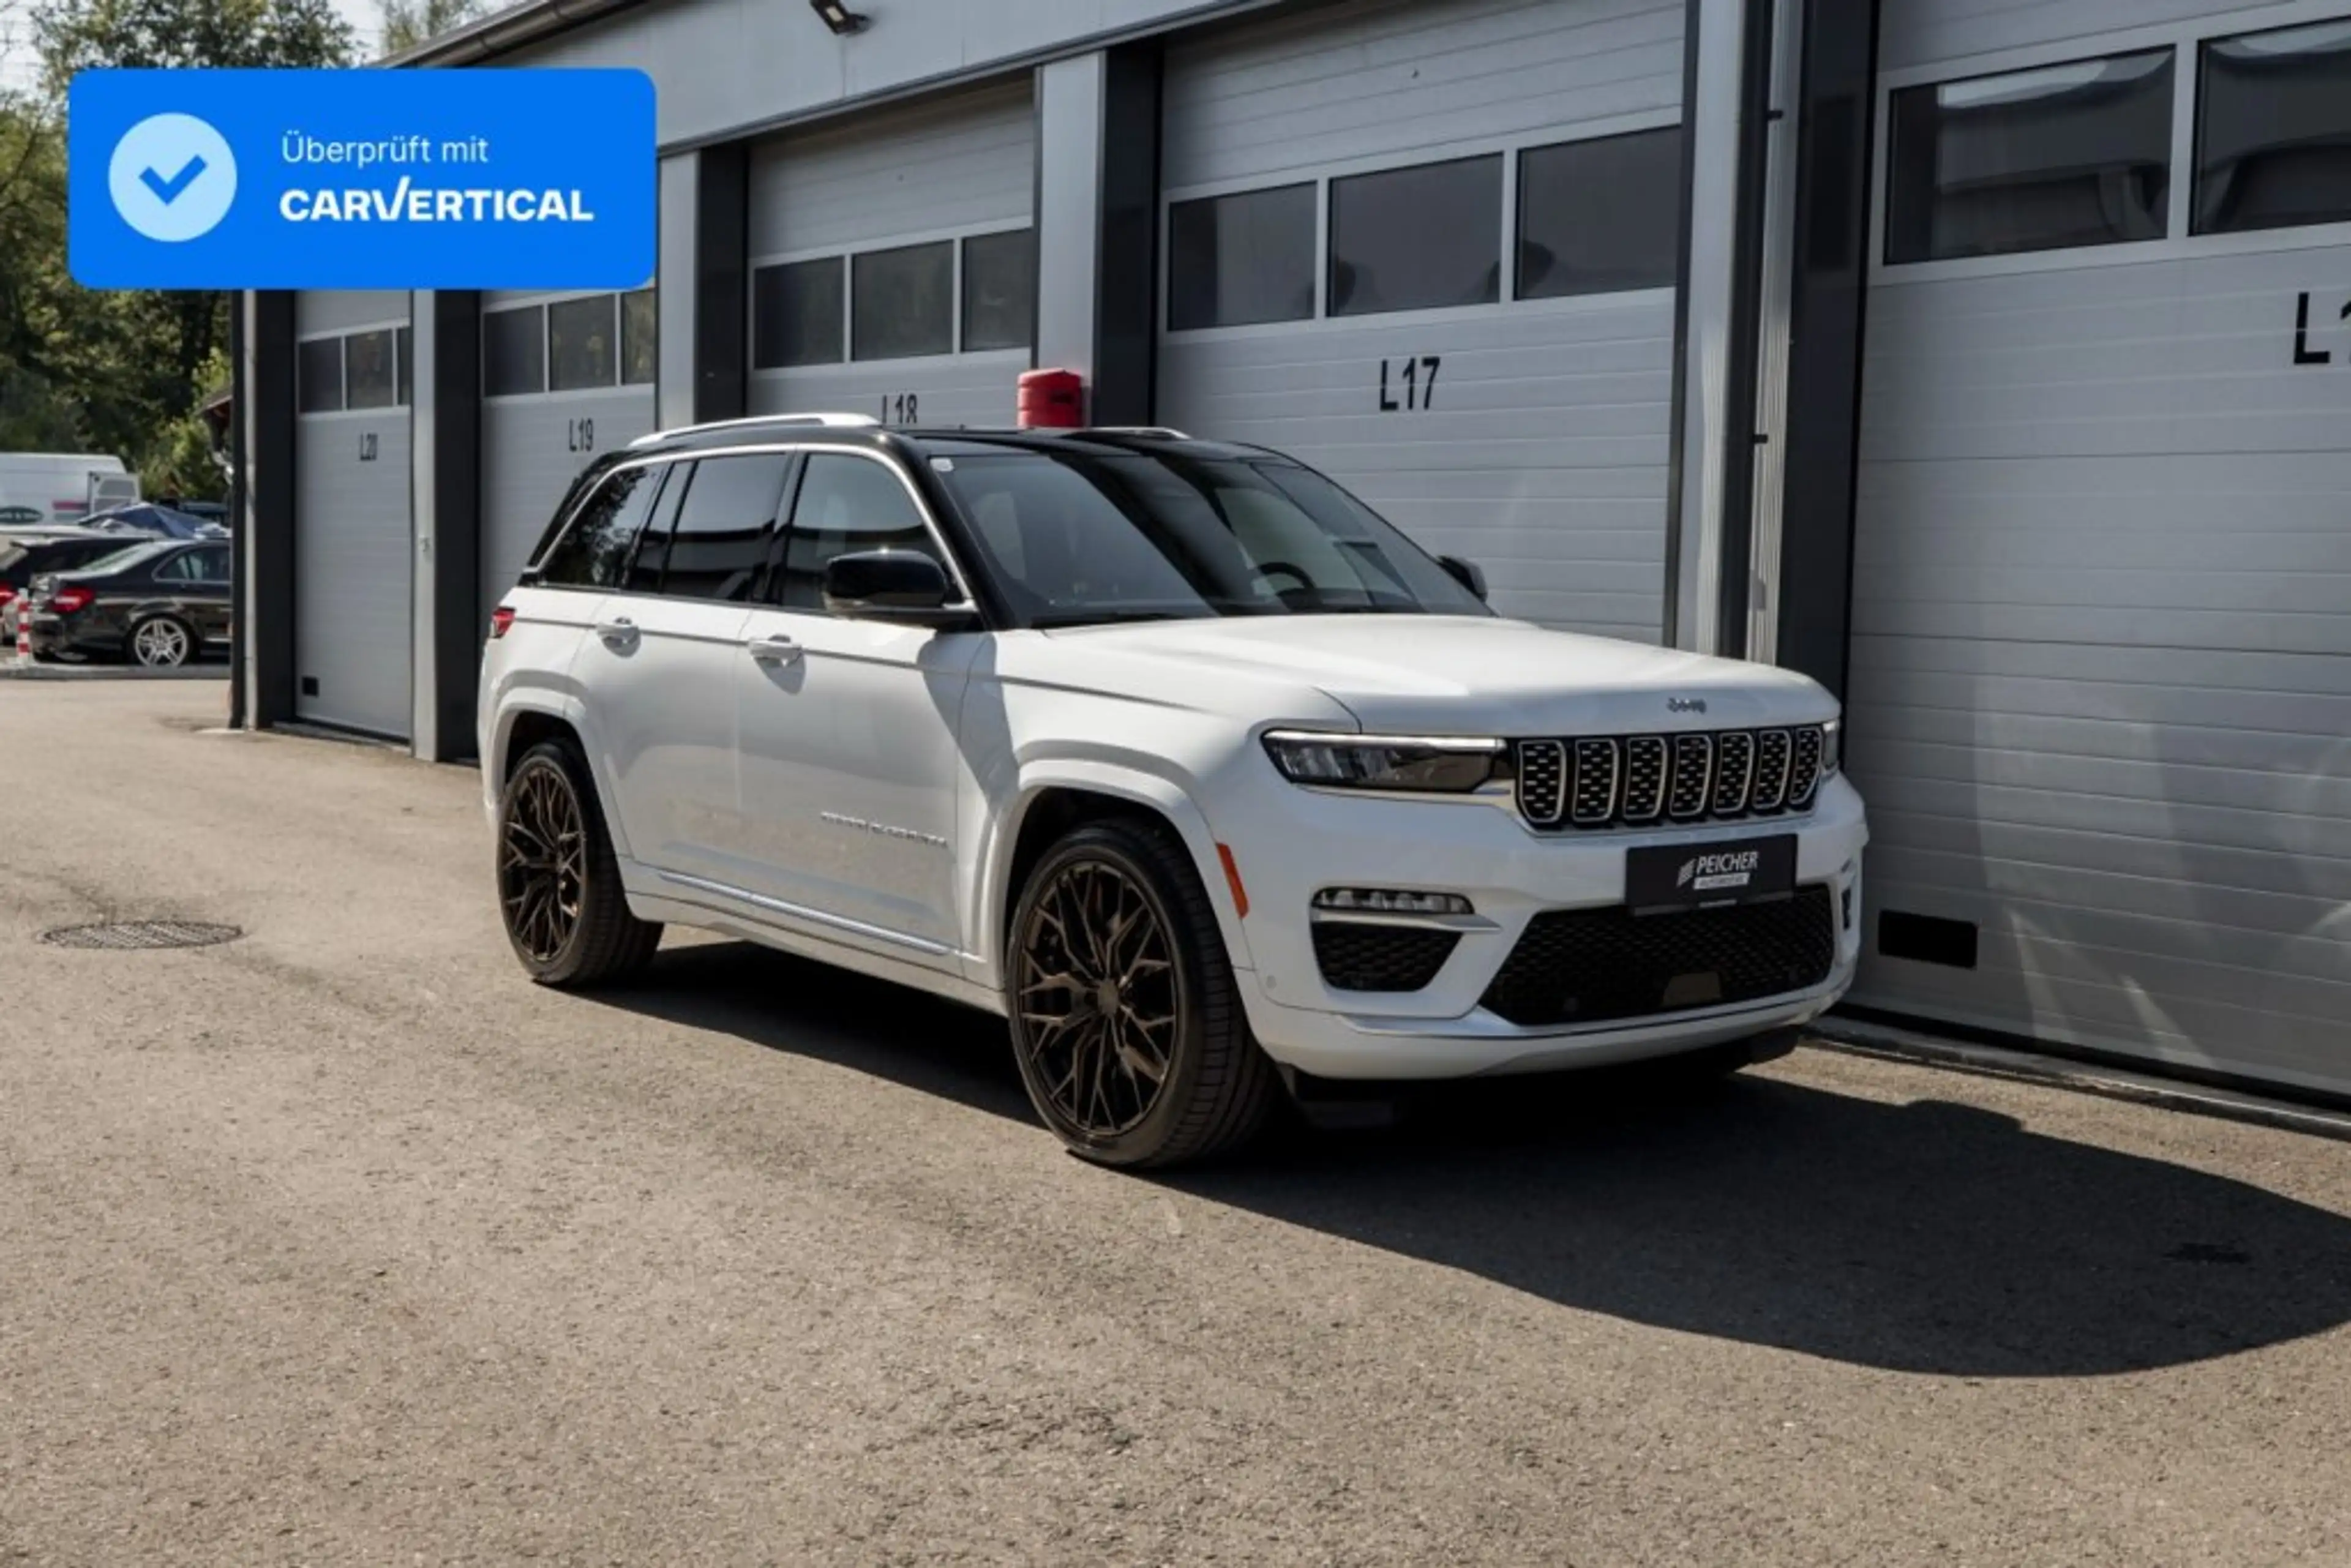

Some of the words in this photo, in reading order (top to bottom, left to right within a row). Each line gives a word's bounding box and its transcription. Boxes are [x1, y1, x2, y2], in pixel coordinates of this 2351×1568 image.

[1379, 356, 1441, 412] L17
[359, 432, 378, 462] L20
[569, 417, 594, 452] L19
[1695, 850, 1760, 875] PEICHER
